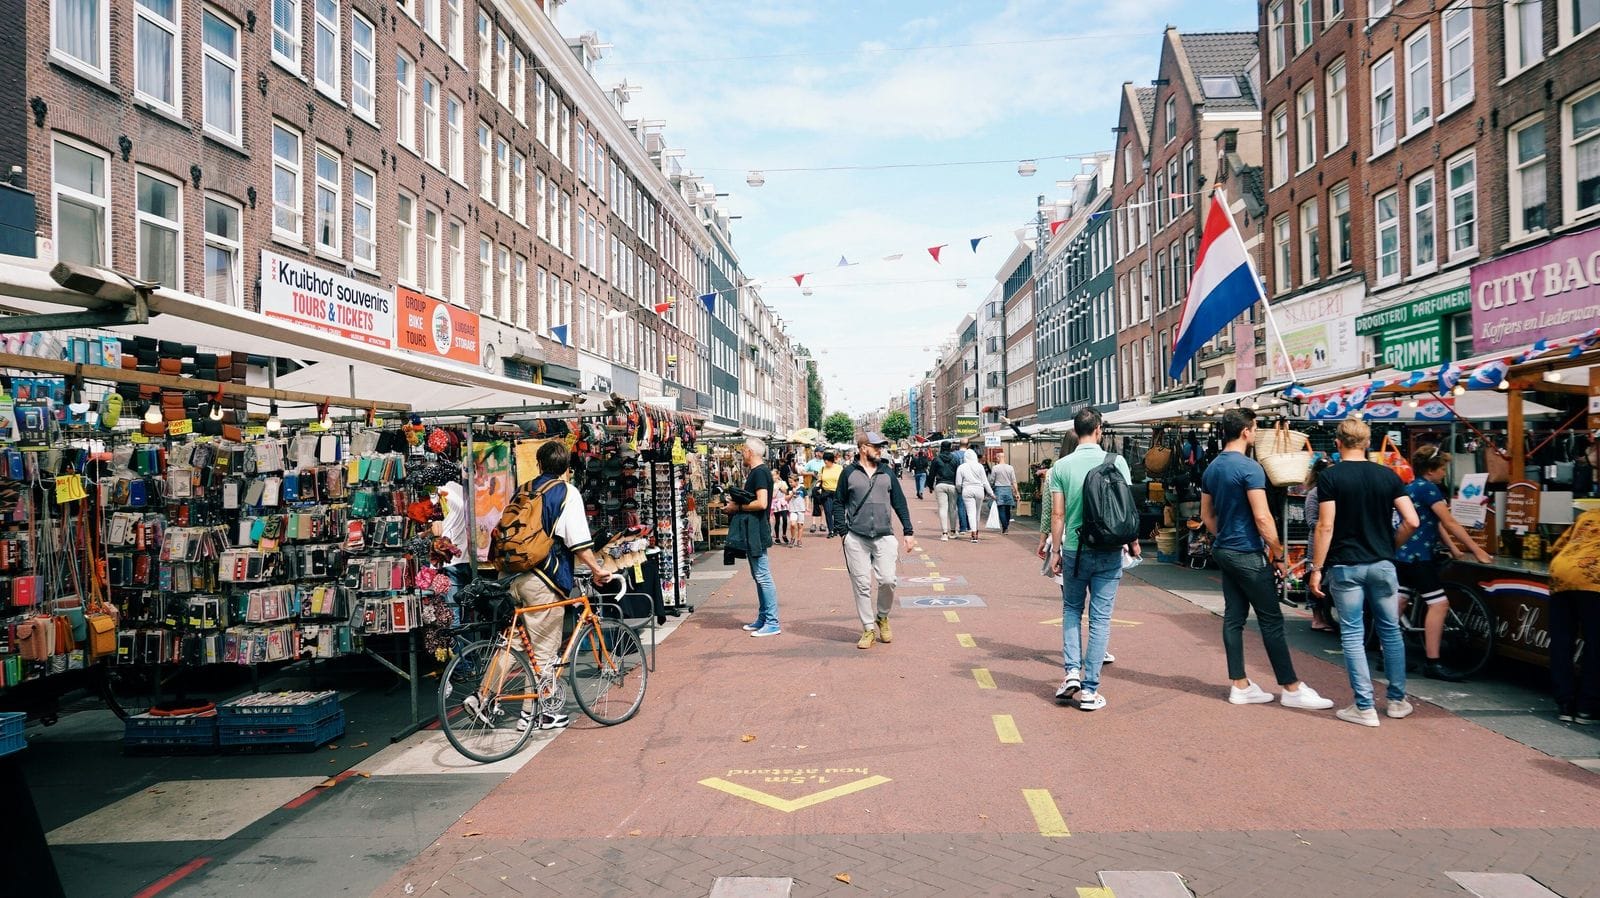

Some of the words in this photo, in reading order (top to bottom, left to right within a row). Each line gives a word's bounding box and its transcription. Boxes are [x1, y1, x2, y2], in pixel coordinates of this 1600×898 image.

[279, 260, 333, 297] Kruithof
[336, 284, 388, 314] souvenirs
[1478, 268, 1538, 311] CITY
[292, 291, 326, 320] TOURS
[328, 302, 335, 321] &
[336, 304, 374, 331] TICKETS
[405, 296, 426, 313] GROUP
[408, 313, 424, 330] BIKE
[1356, 306, 1408, 332] DROGISTERIJ
[1480, 316, 1522, 344] Koffers
[1523, 317, 1538, 331] en
[406, 330, 427, 347] TOURS
[1384, 336, 1440, 370] GRIMME
[726, 768, 819, 777] afstand
[825, 767, 869, 775] hou
